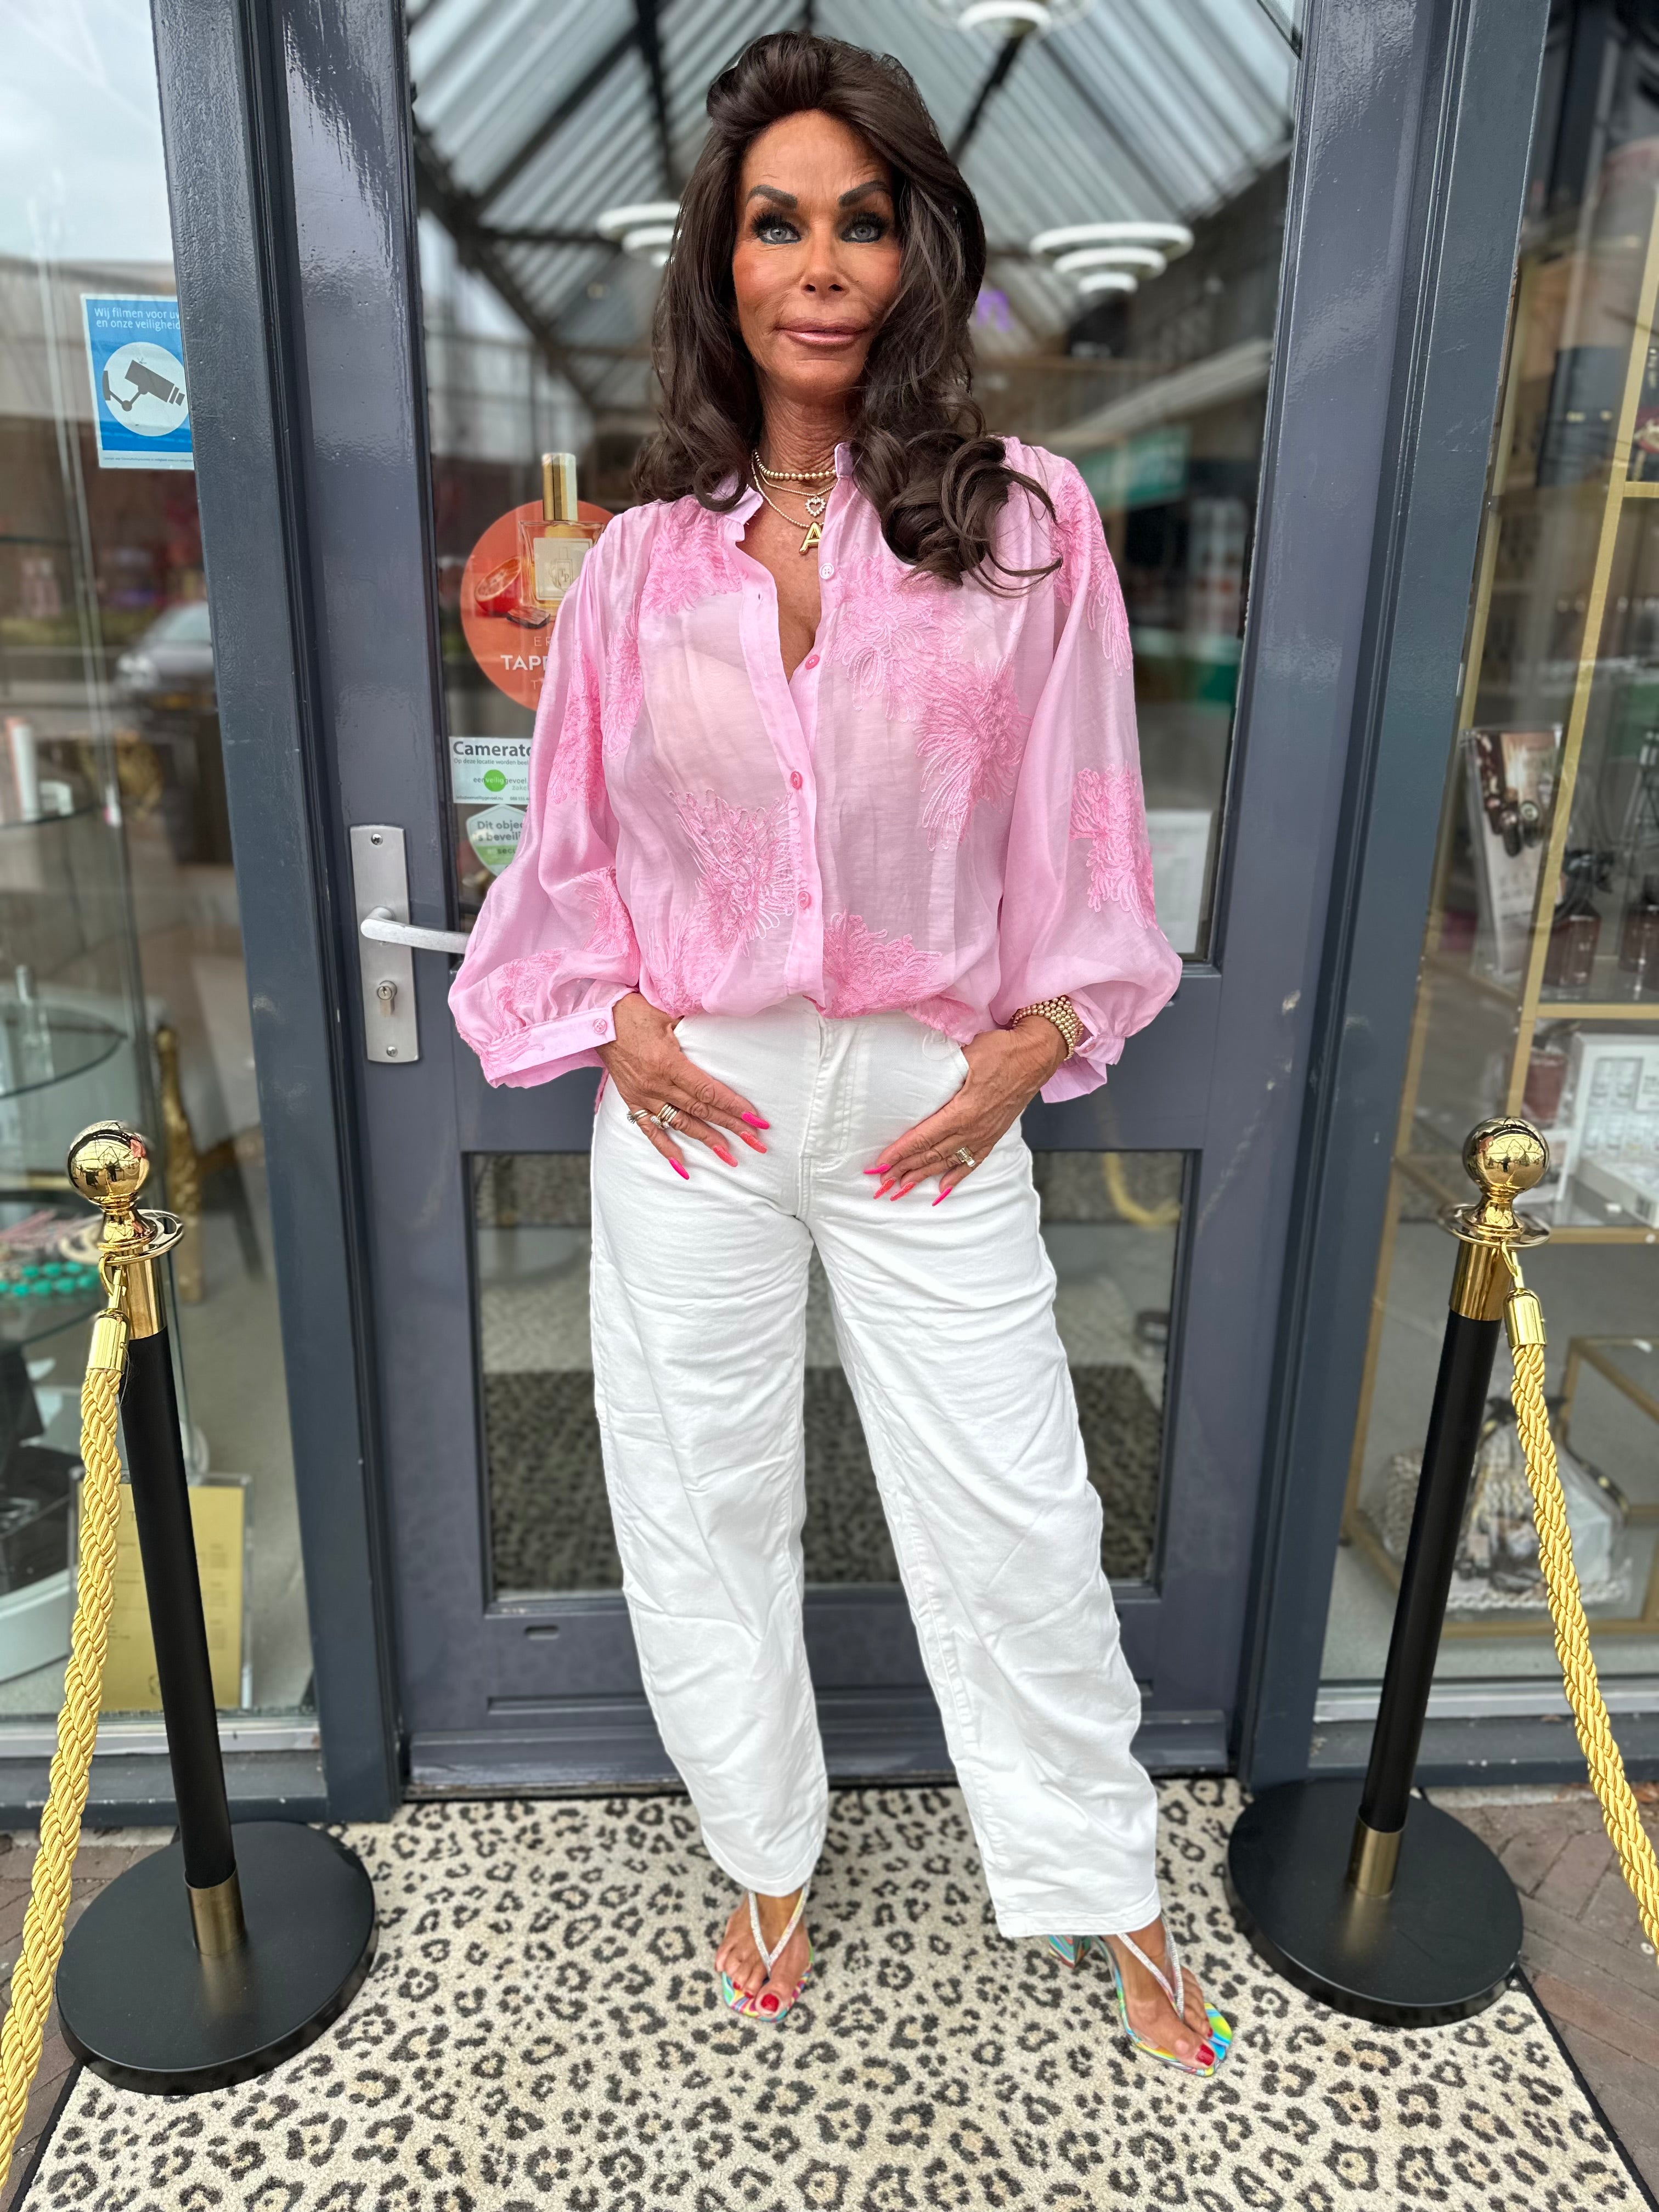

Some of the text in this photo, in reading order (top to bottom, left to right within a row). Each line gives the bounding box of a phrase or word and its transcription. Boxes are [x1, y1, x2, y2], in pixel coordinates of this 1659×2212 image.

[94, 308, 110, 319] Wij
[112, 308, 143, 318] filmen
[477, 820, 493, 830] Dit
